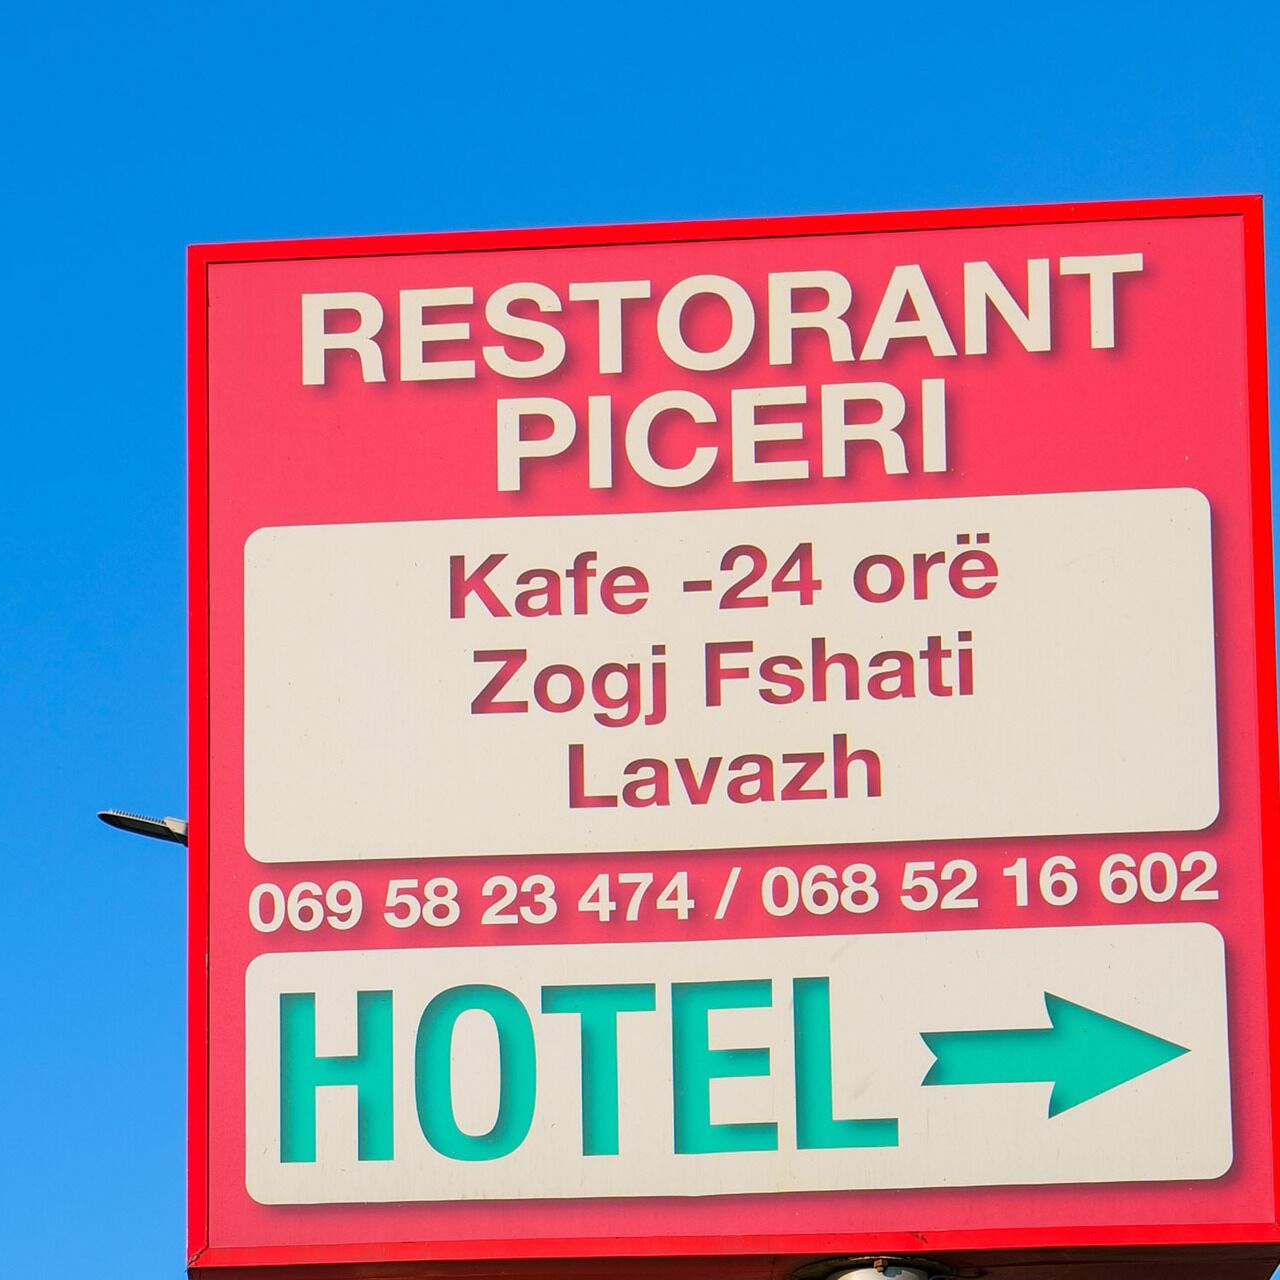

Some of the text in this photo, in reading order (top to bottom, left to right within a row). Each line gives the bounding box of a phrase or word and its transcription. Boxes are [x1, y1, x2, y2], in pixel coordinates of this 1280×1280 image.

[301, 253, 1144, 387] RESTORANT
[496, 377, 949, 492] PICERI
[452, 553, 649, 618] Kafe
[856, 535, 998, 603] orë
[473, 633, 973, 728] Zogj Fshati
[568, 733, 882, 809] Lavazh
[249, 851, 1219, 932] 069 58 23 474 / 068 52 16 602
[279, 975, 899, 1163] HOTEL
